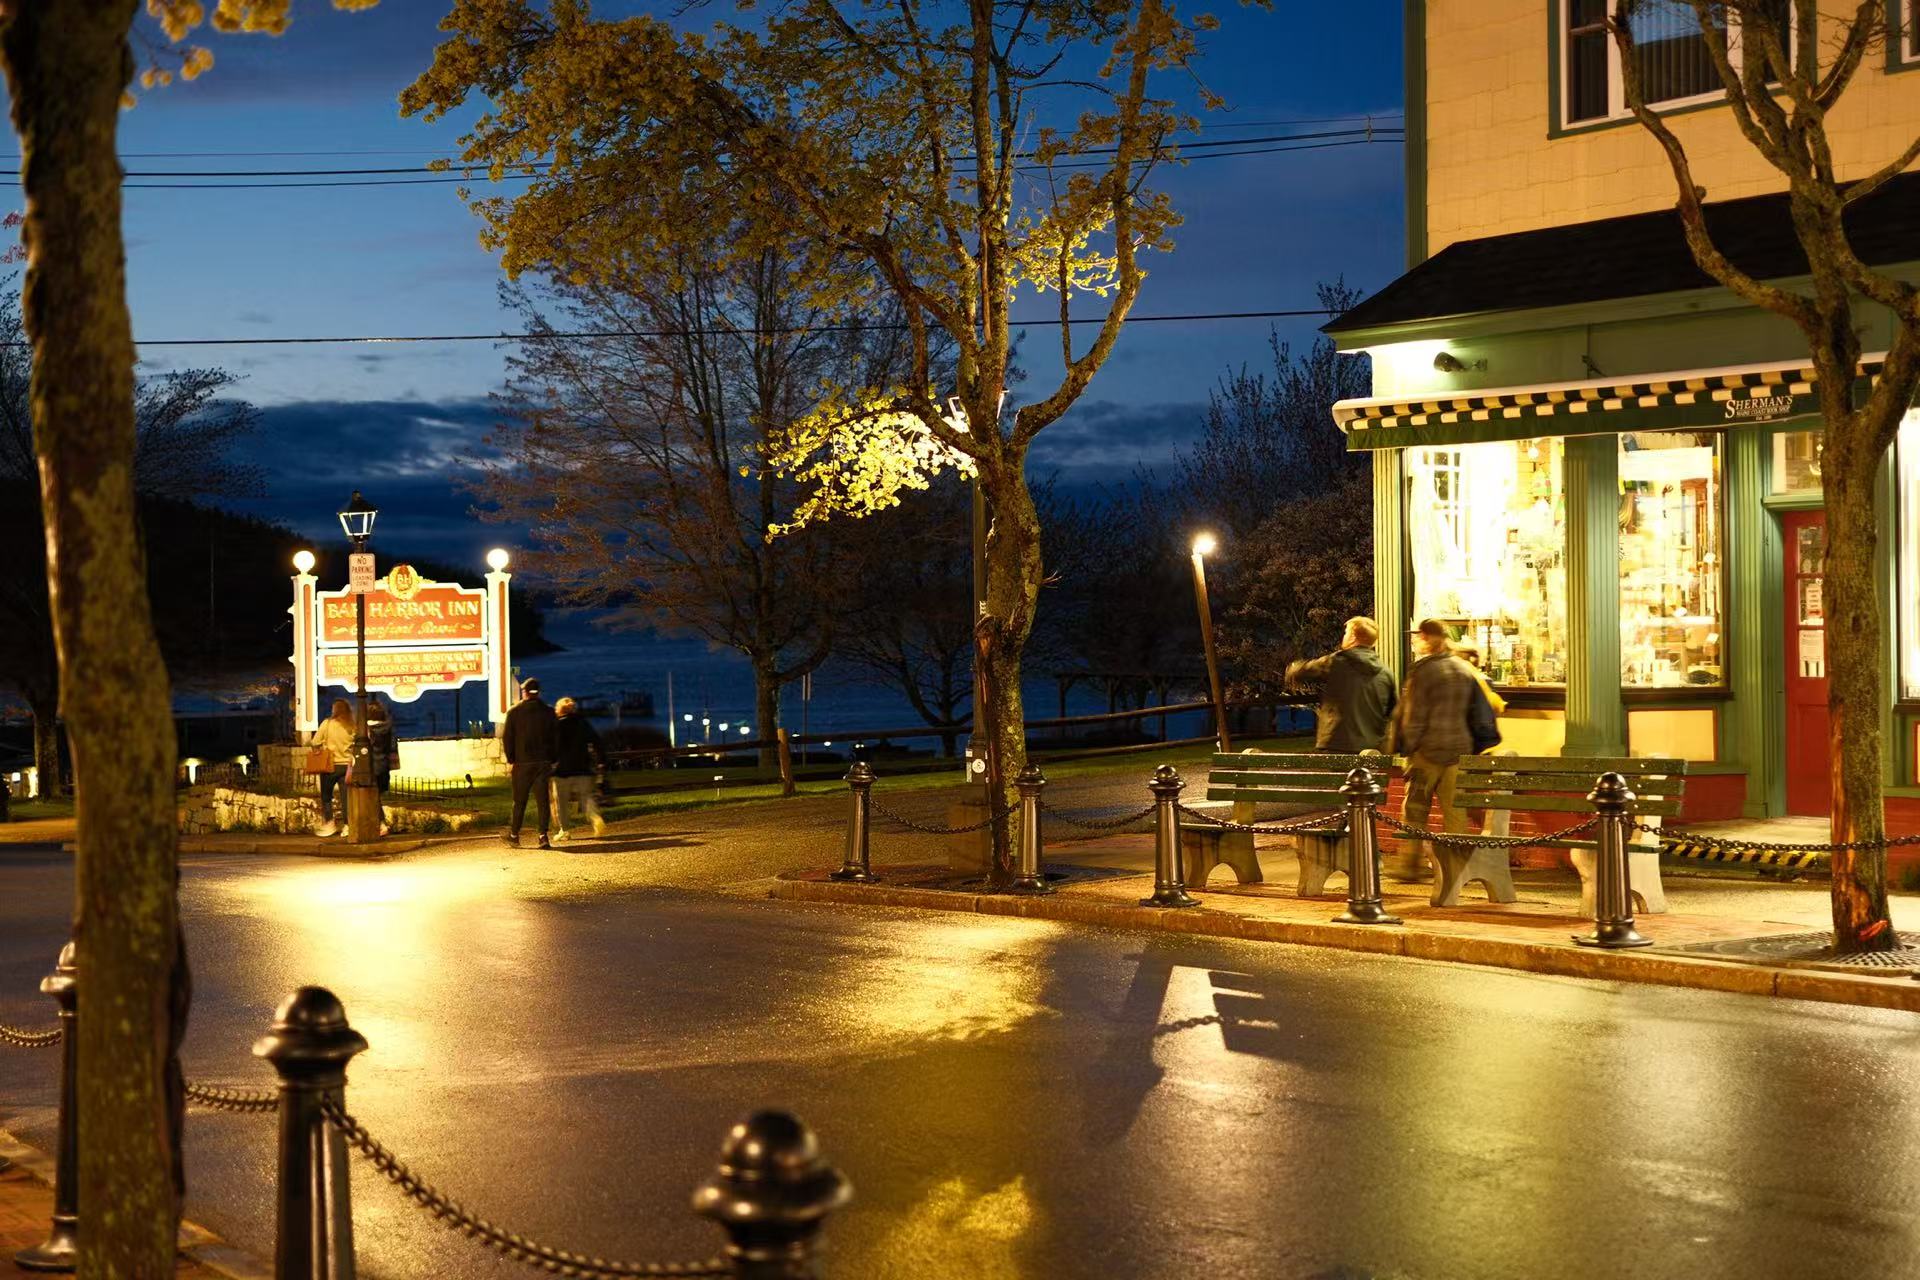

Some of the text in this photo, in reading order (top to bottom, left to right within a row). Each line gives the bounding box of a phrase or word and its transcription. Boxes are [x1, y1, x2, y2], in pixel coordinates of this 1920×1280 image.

[1725, 395, 1793, 418] SHERMAN'S
[357, 557, 367, 565] NO
[352, 566, 374, 574] PARKING
[369, 600, 443, 619] HARBOR
[448, 600, 479, 616] INN
